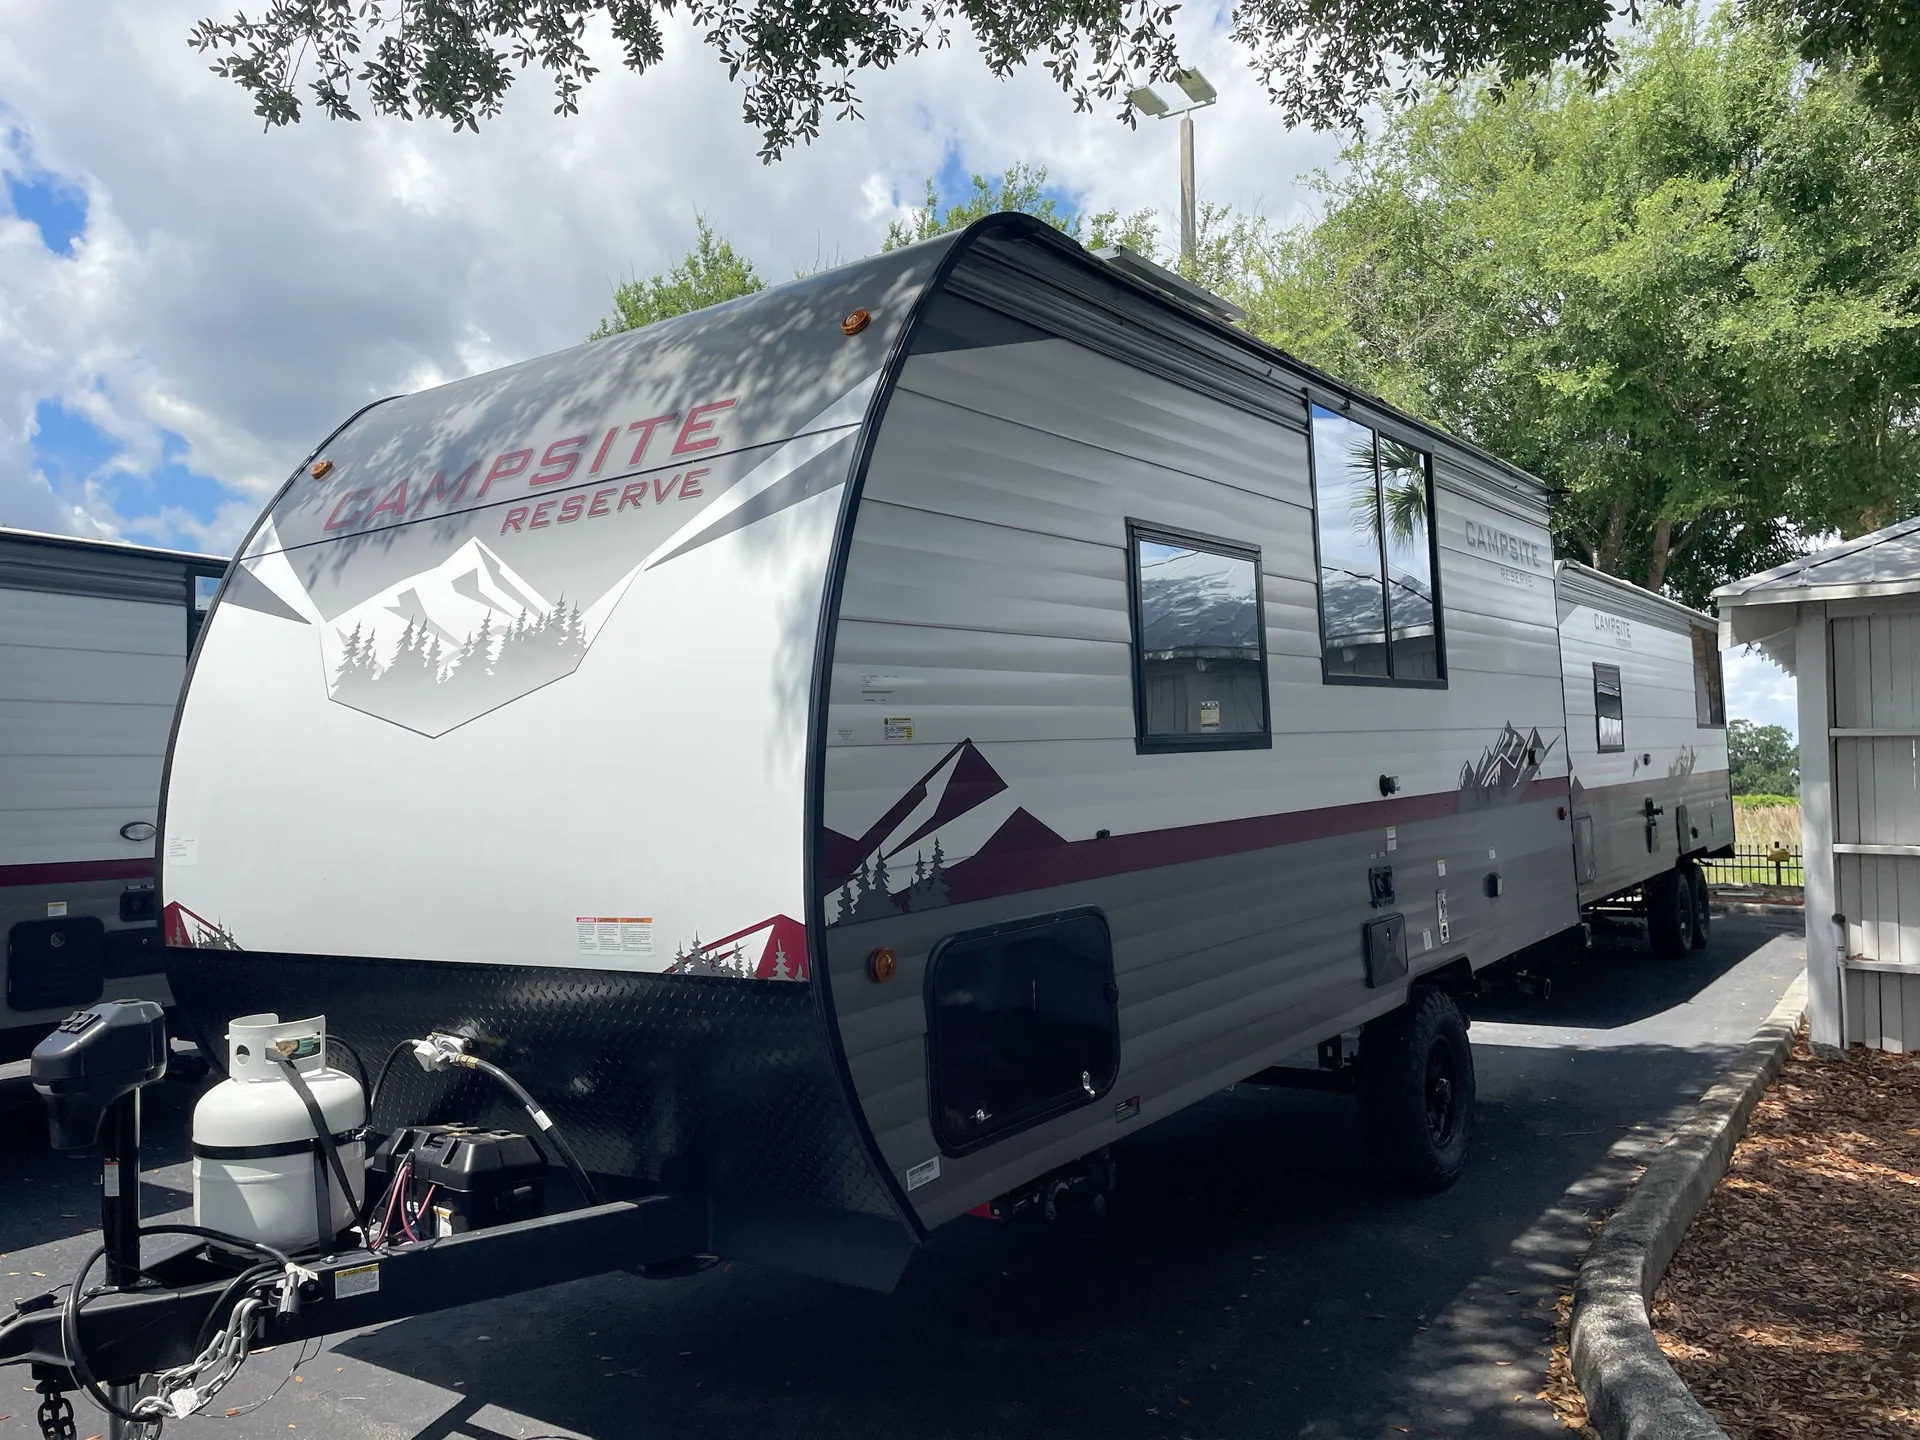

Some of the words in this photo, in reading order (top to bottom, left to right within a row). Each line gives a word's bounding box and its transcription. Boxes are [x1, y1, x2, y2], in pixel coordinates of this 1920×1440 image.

[323, 397, 740, 533] CAMPSITE
[500, 467, 711, 536] RESERVE
[1465, 520, 1541, 568] CAMPSITE
[1500, 567, 1533, 588] RESERVE
[1594, 612, 1632, 638] CAMPSITE
